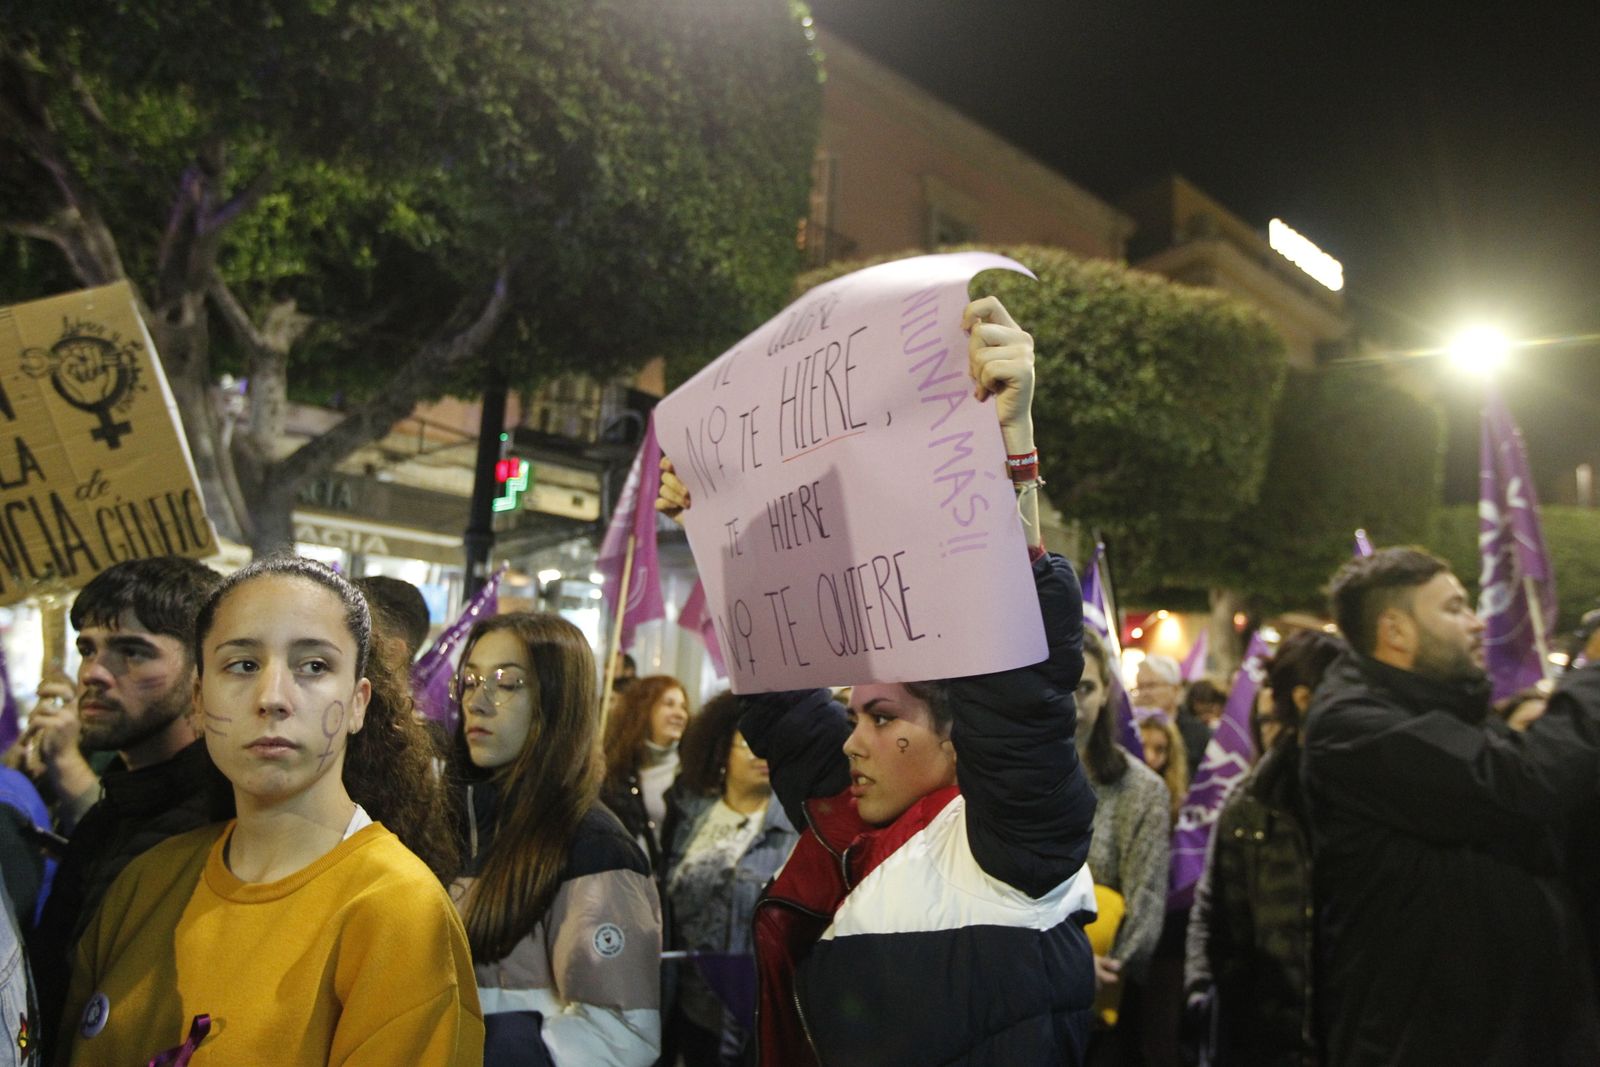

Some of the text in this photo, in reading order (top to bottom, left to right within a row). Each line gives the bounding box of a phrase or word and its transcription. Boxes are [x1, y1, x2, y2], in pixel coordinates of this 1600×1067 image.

[739, 405, 763, 473] TE
[725, 480, 831, 559] TE HIERE
[764, 586, 810, 667] TE
